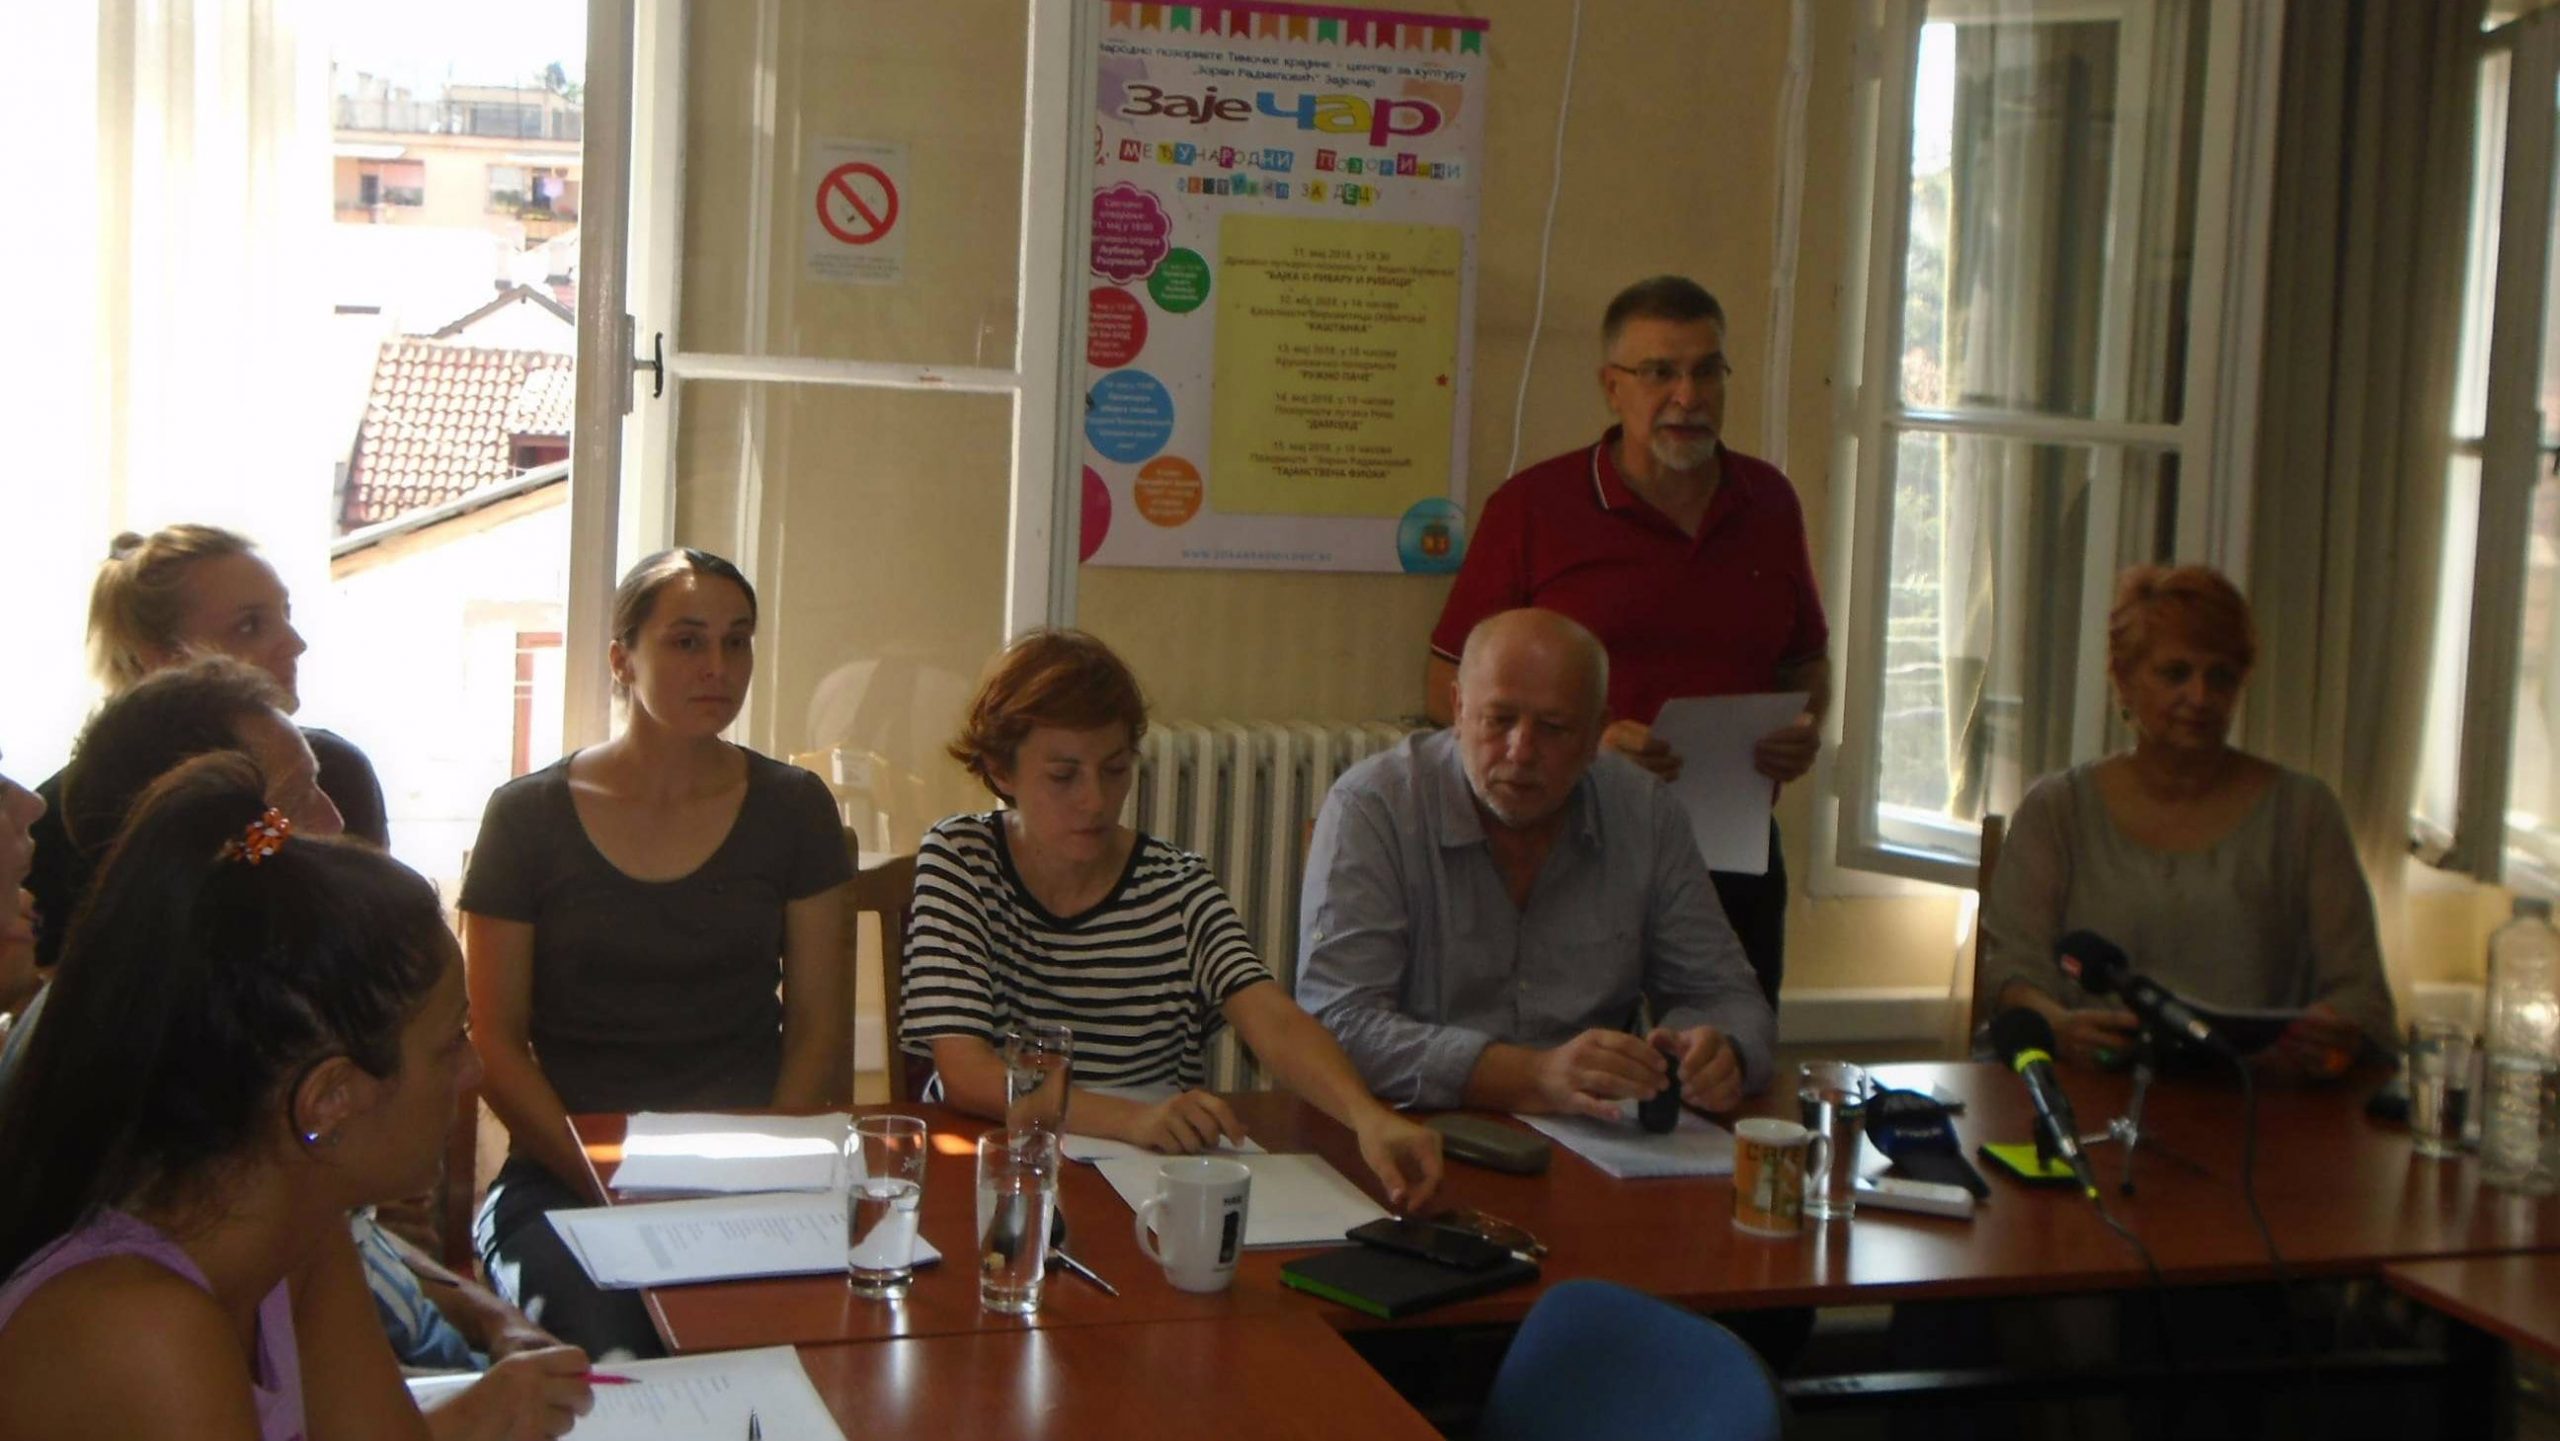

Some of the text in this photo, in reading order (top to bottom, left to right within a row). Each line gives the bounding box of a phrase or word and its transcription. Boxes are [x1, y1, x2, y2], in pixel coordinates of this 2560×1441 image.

[1413, 66, 1467, 82] културу
[1120, 138, 1294, 172] МЕЂУНАРОДНИ
[1301, 182, 1327, 201] ЗА
[1335, 182, 1382, 206] ДЕЦУ
